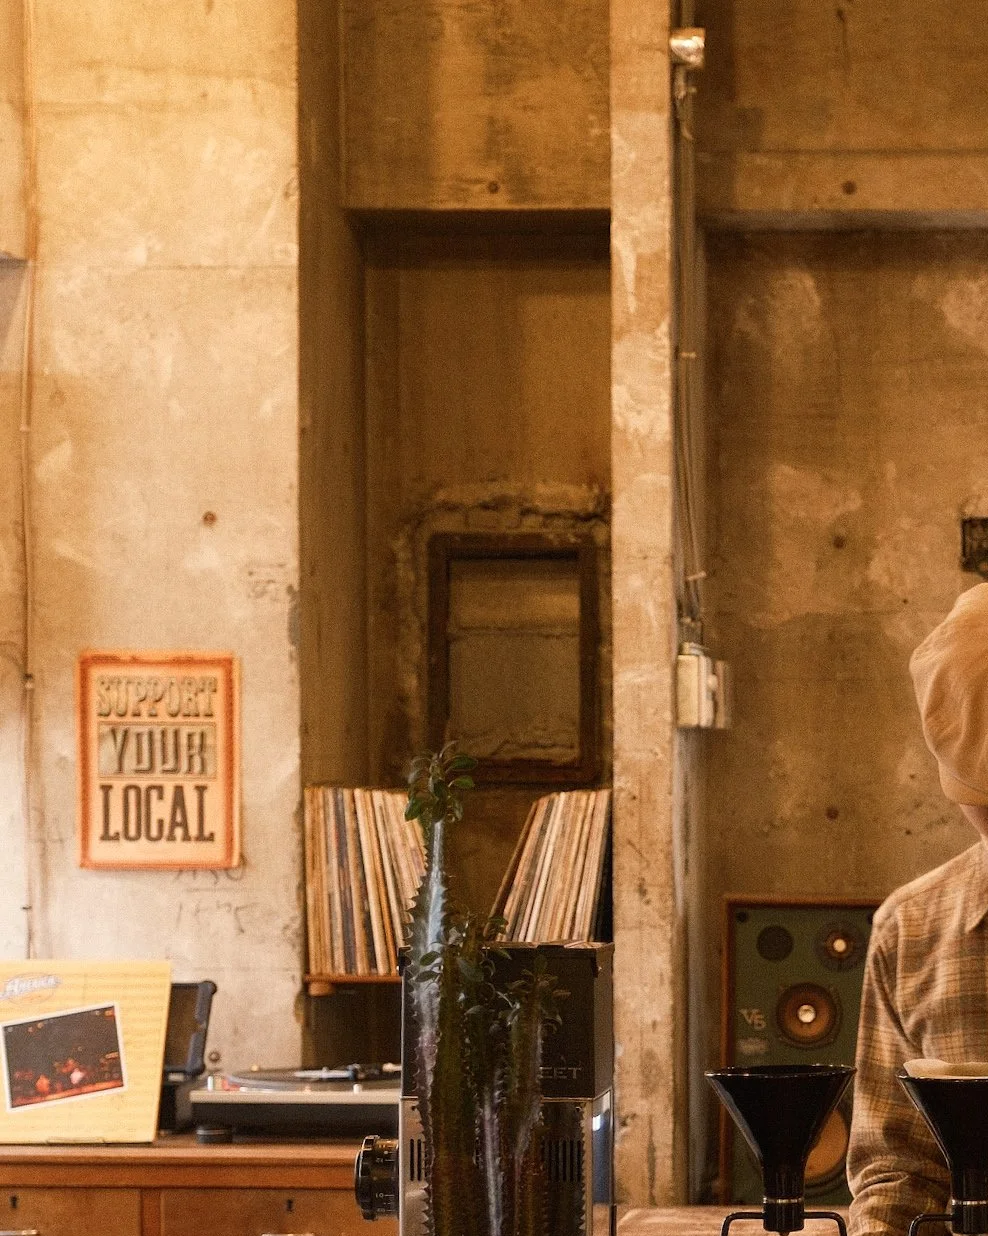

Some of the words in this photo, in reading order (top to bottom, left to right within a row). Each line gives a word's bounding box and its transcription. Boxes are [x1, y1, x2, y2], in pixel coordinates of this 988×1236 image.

[97, 676, 217, 718] SUPPORT
[109, 727, 208, 775] YOUR
[99, 784, 216, 843] LOCAL
